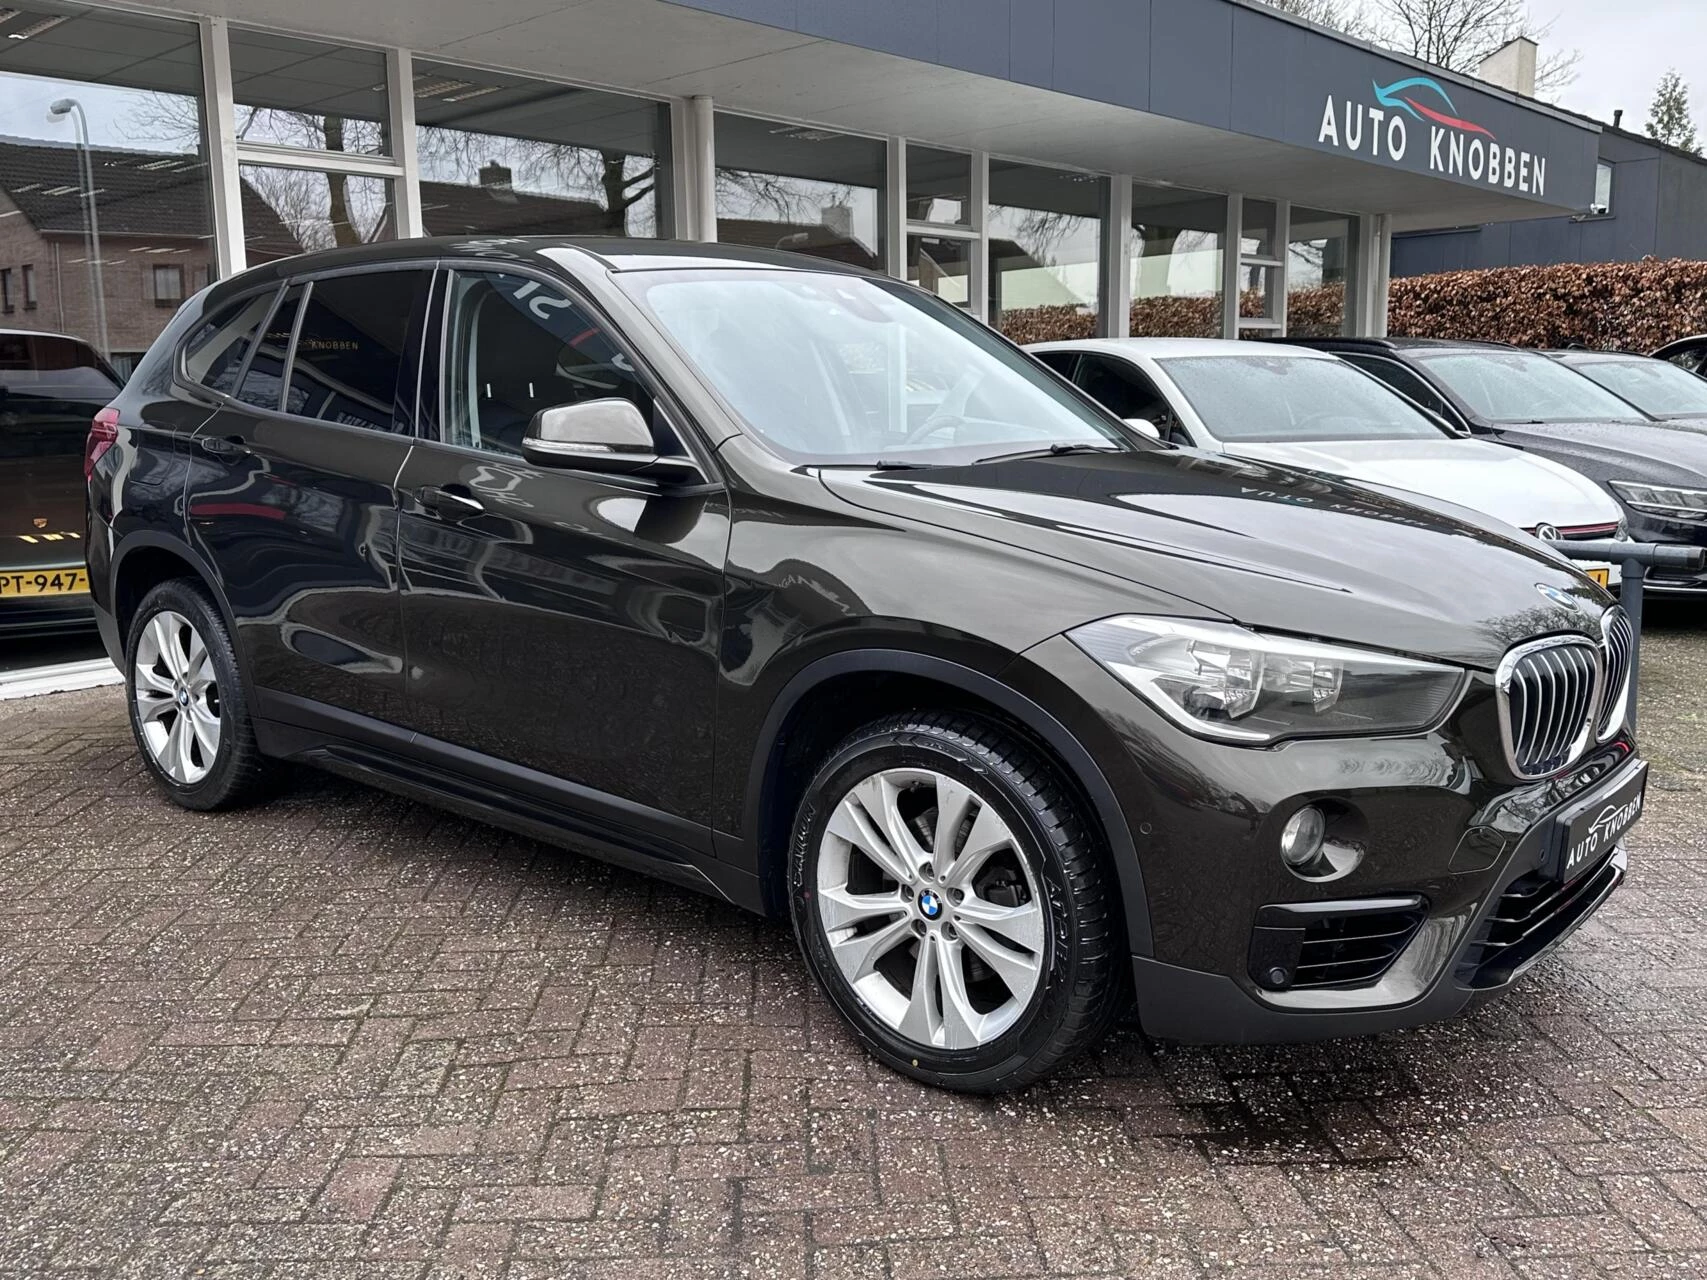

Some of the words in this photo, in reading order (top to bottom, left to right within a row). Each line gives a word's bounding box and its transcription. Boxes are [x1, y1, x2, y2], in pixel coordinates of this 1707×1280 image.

[1318, 95, 1407, 162] AUTO
[1429, 126, 1546, 196] KNOBBEN
[311, 340, 359, 350] KNOBBEN
[1566, 831, 1598, 870] AUTO
[1603, 792, 1641, 842] KNOBBEN
